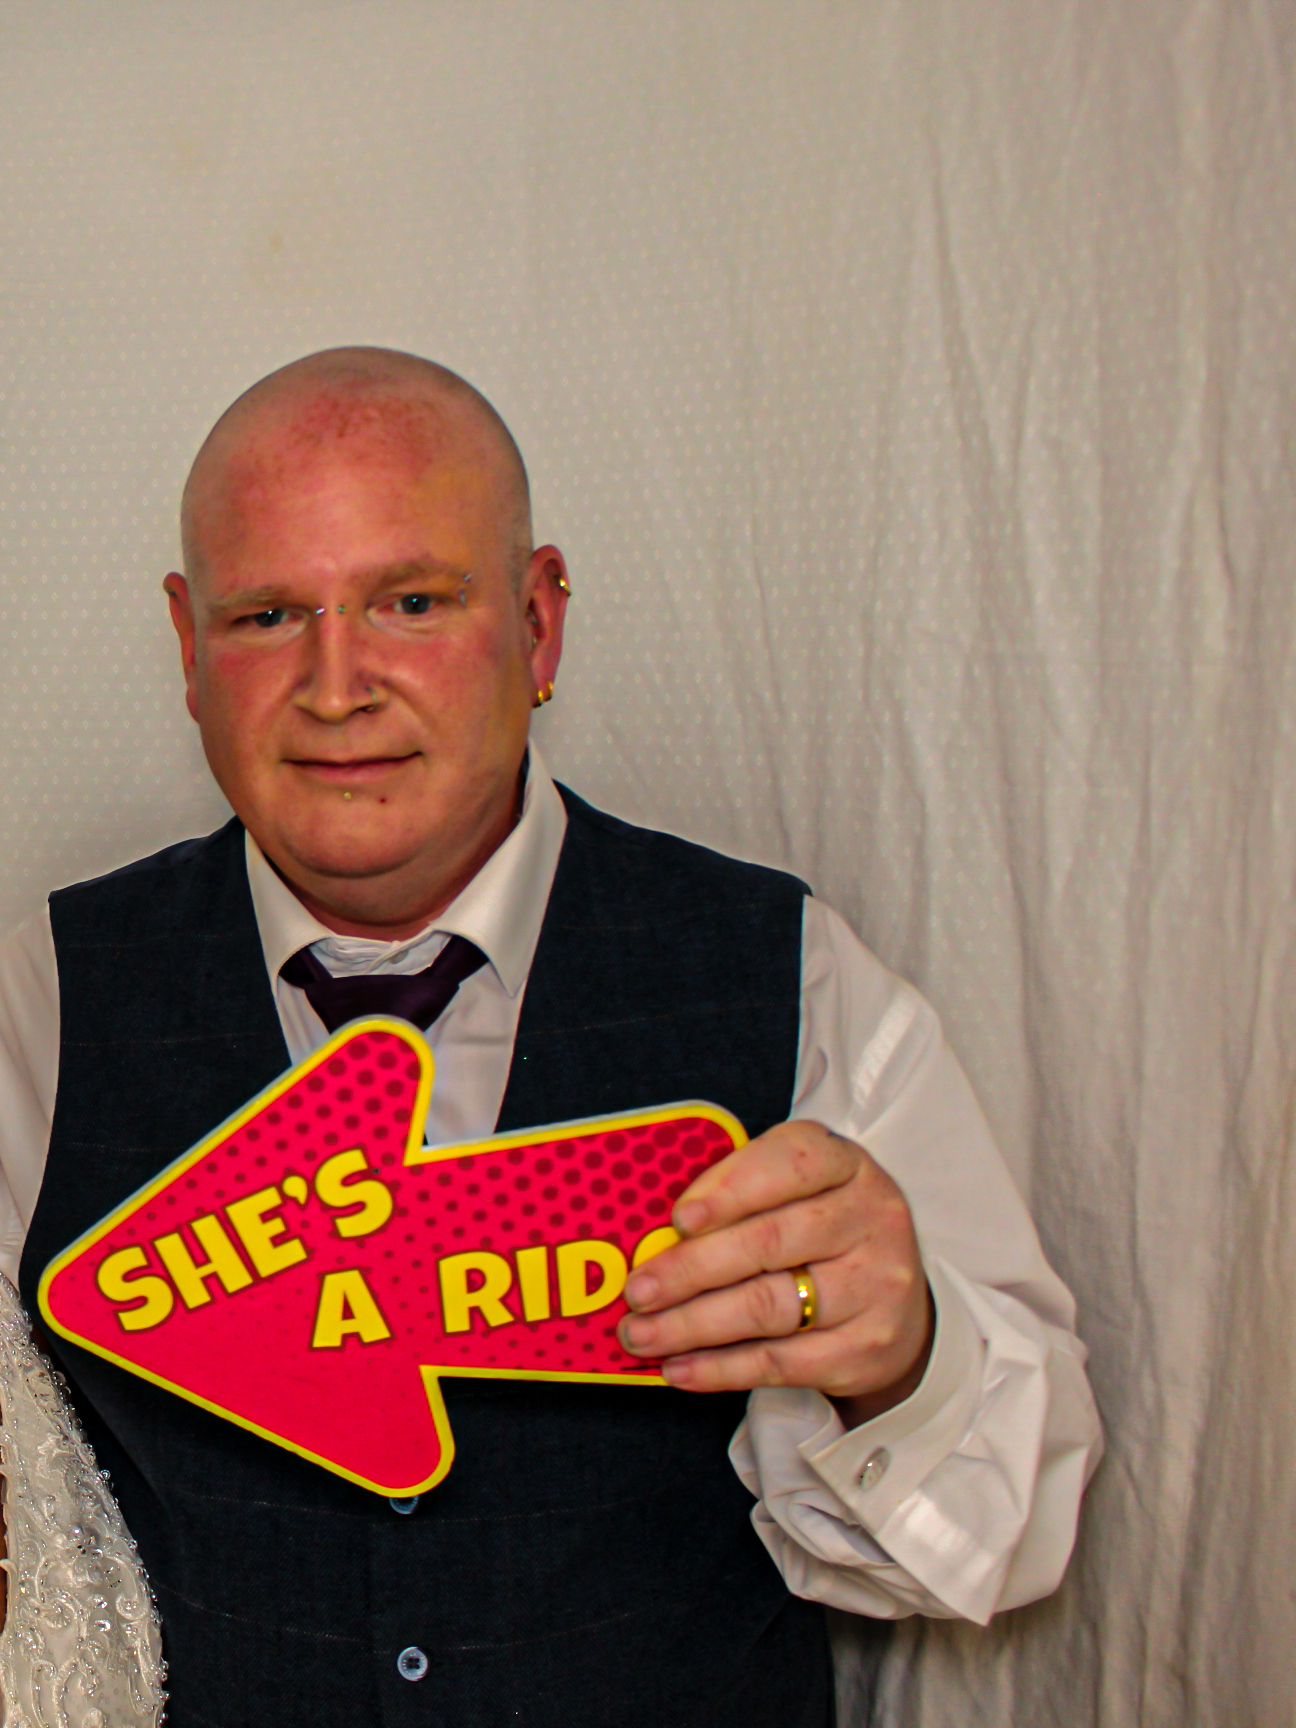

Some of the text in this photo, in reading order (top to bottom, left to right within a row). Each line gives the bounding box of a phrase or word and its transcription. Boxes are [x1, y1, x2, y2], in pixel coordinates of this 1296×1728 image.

[95, 1147, 394, 1332] SHE'S
[311, 1225, 682, 1349] A RID
